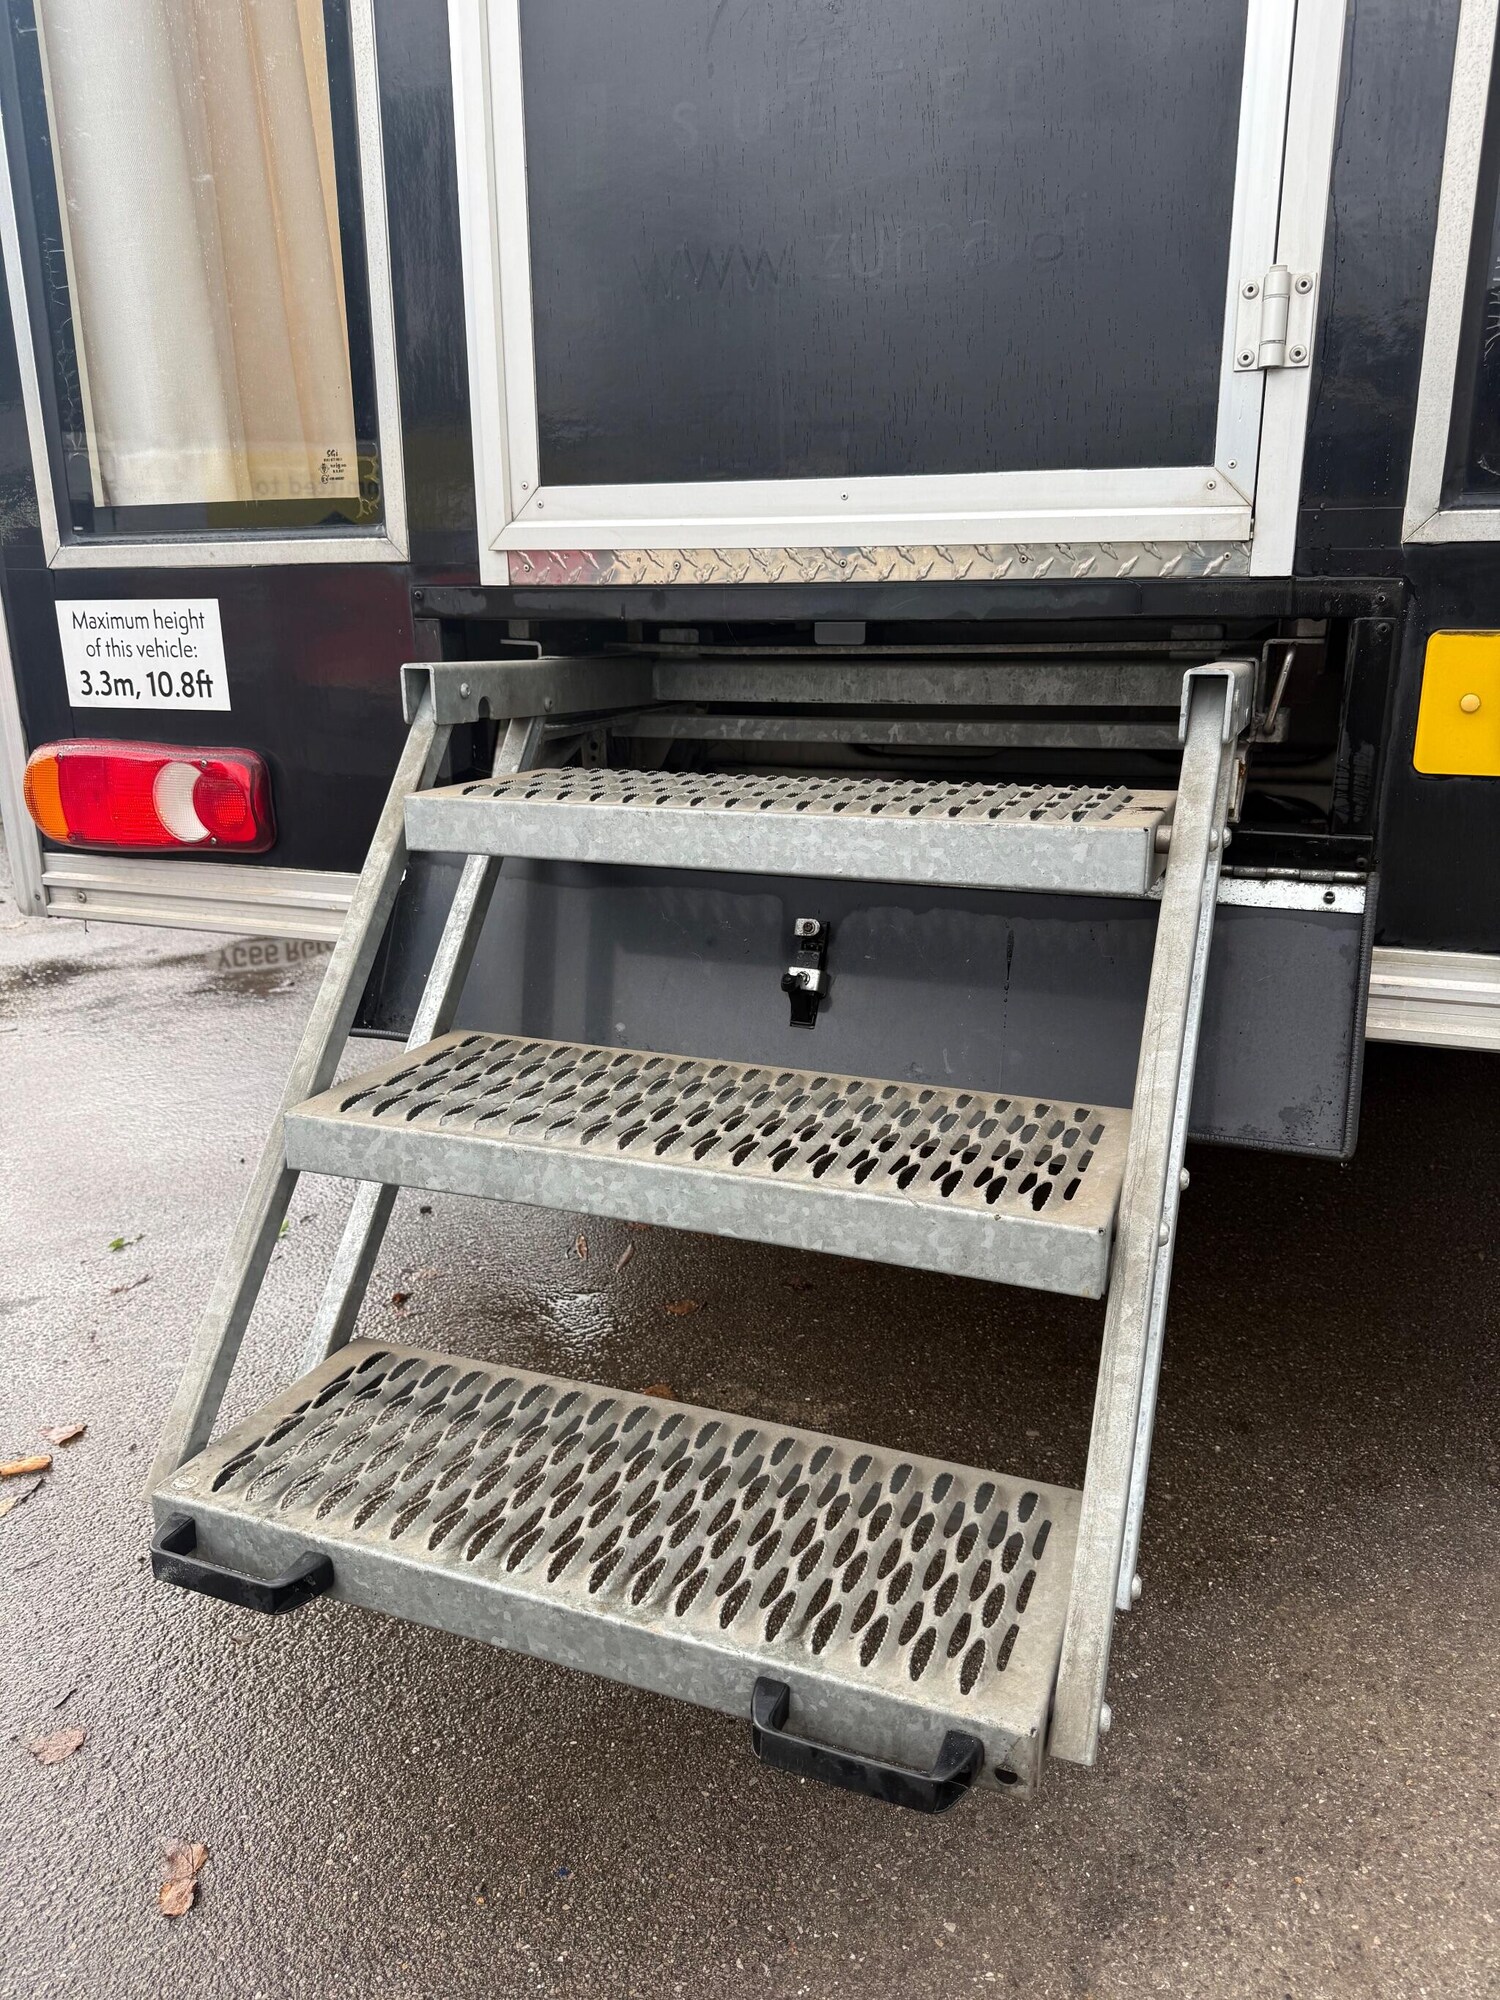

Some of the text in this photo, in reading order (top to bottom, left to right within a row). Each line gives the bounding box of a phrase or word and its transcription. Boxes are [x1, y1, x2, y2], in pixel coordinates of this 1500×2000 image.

[72, 608, 205, 635] Maximum height
[86, 637, 198, 658] of this vehicle:
[80, 668, 214, 700] 3.3m, 10.8ft
